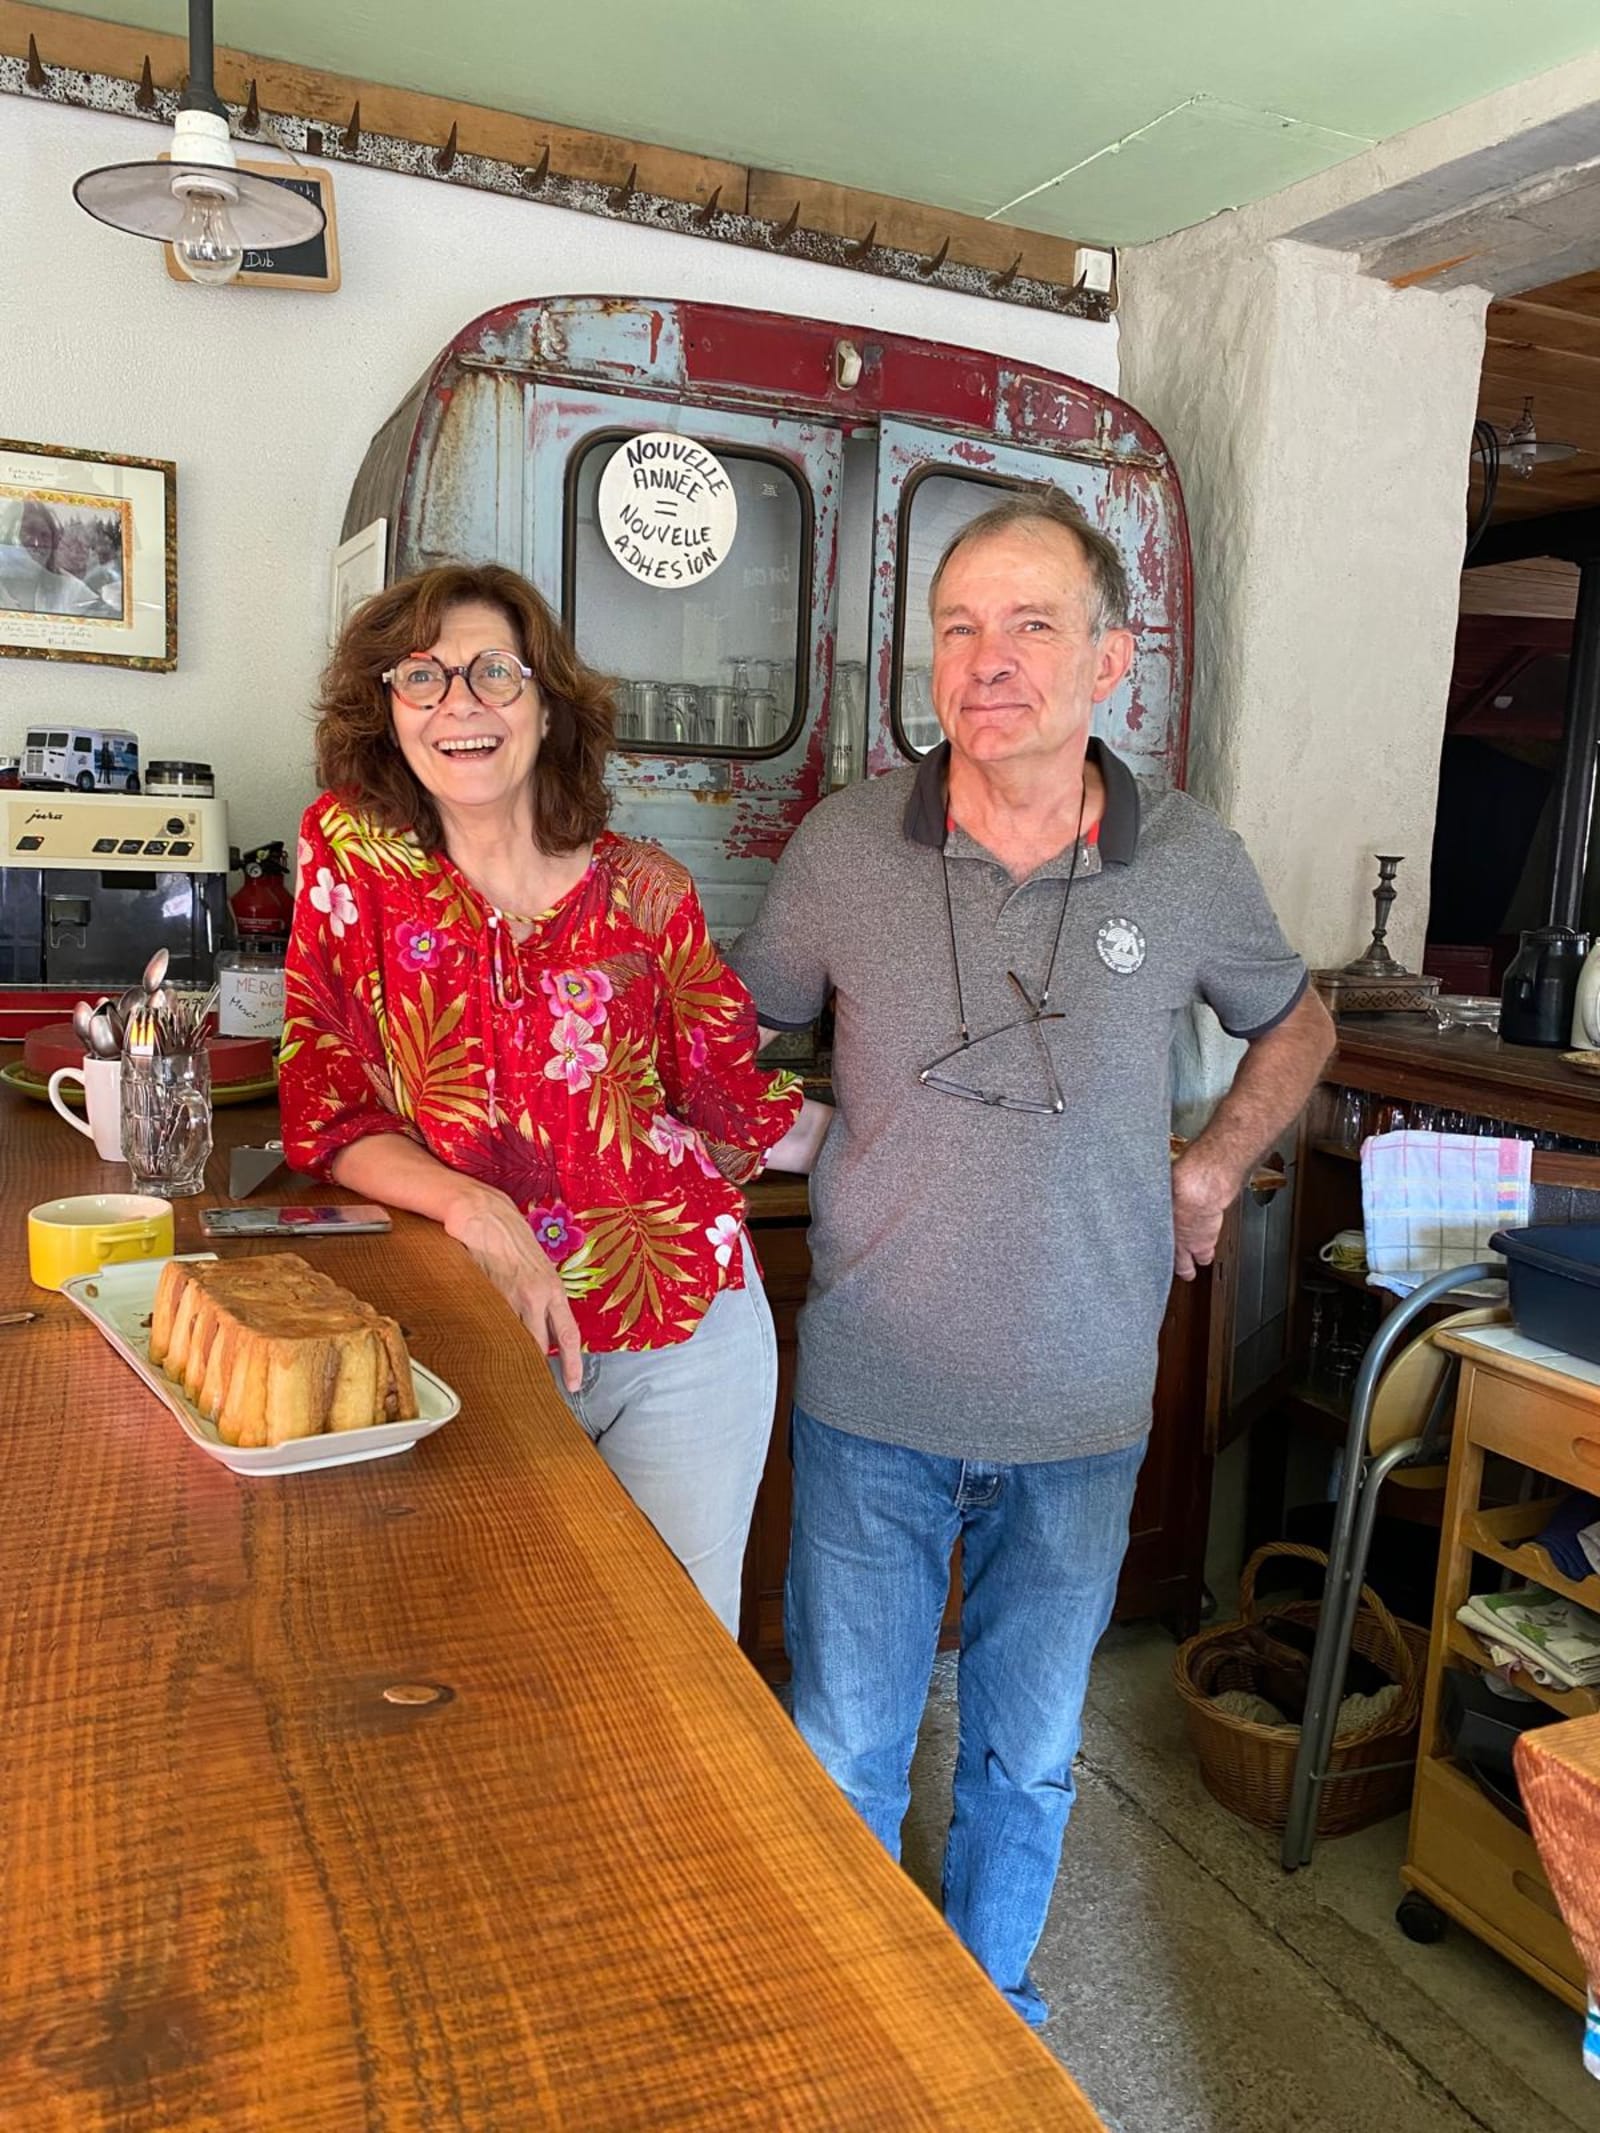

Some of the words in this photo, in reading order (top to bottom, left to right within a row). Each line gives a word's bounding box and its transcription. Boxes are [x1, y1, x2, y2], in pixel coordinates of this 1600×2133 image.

[626, 439, 729, 497] NOUVELLE
[633, 467, 703, 503] ANNÉE
[619, 504, 712, 547] NOUVELLE
